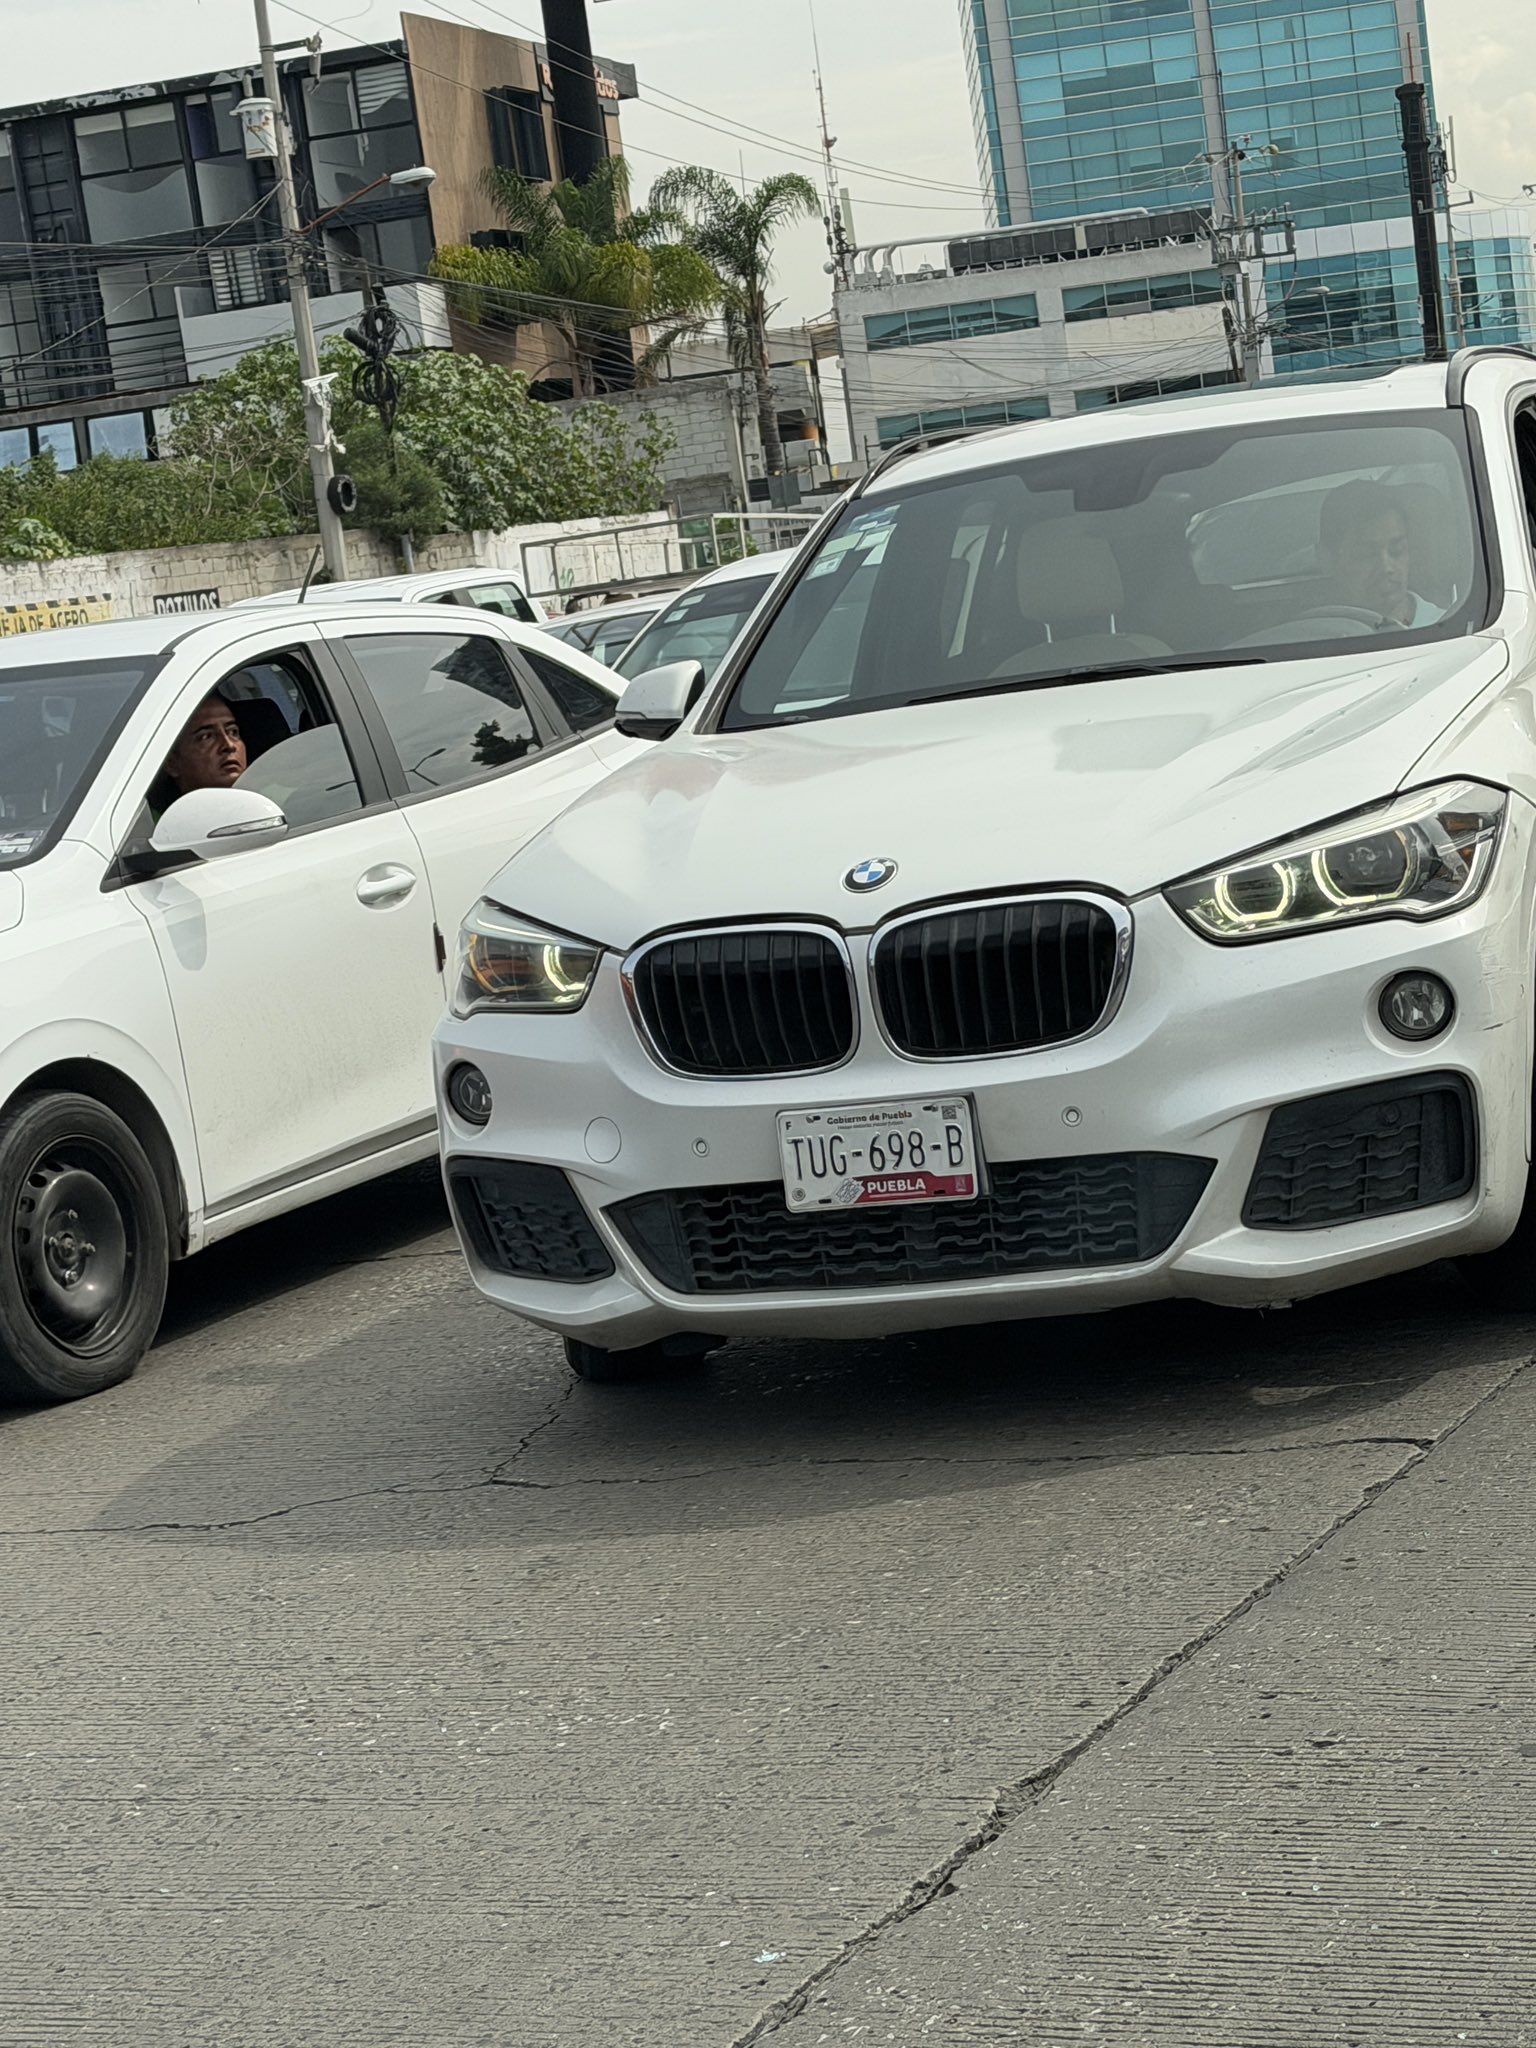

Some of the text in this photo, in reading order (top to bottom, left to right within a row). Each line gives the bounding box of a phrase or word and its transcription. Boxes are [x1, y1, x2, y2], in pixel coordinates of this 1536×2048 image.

[0, 609, 89, 636] EJA DE ACERO
[827, 1115, 867, 1125] Gobierno
[869, 1113, 881, 1121] de
[882, 1110, 913, 1120] Puebla
[785, 1121, 792, 1130] F
[787, 1124, 964, 1180] TUG-698-B
[867, 1178, 926, 1193] PUEBLA
